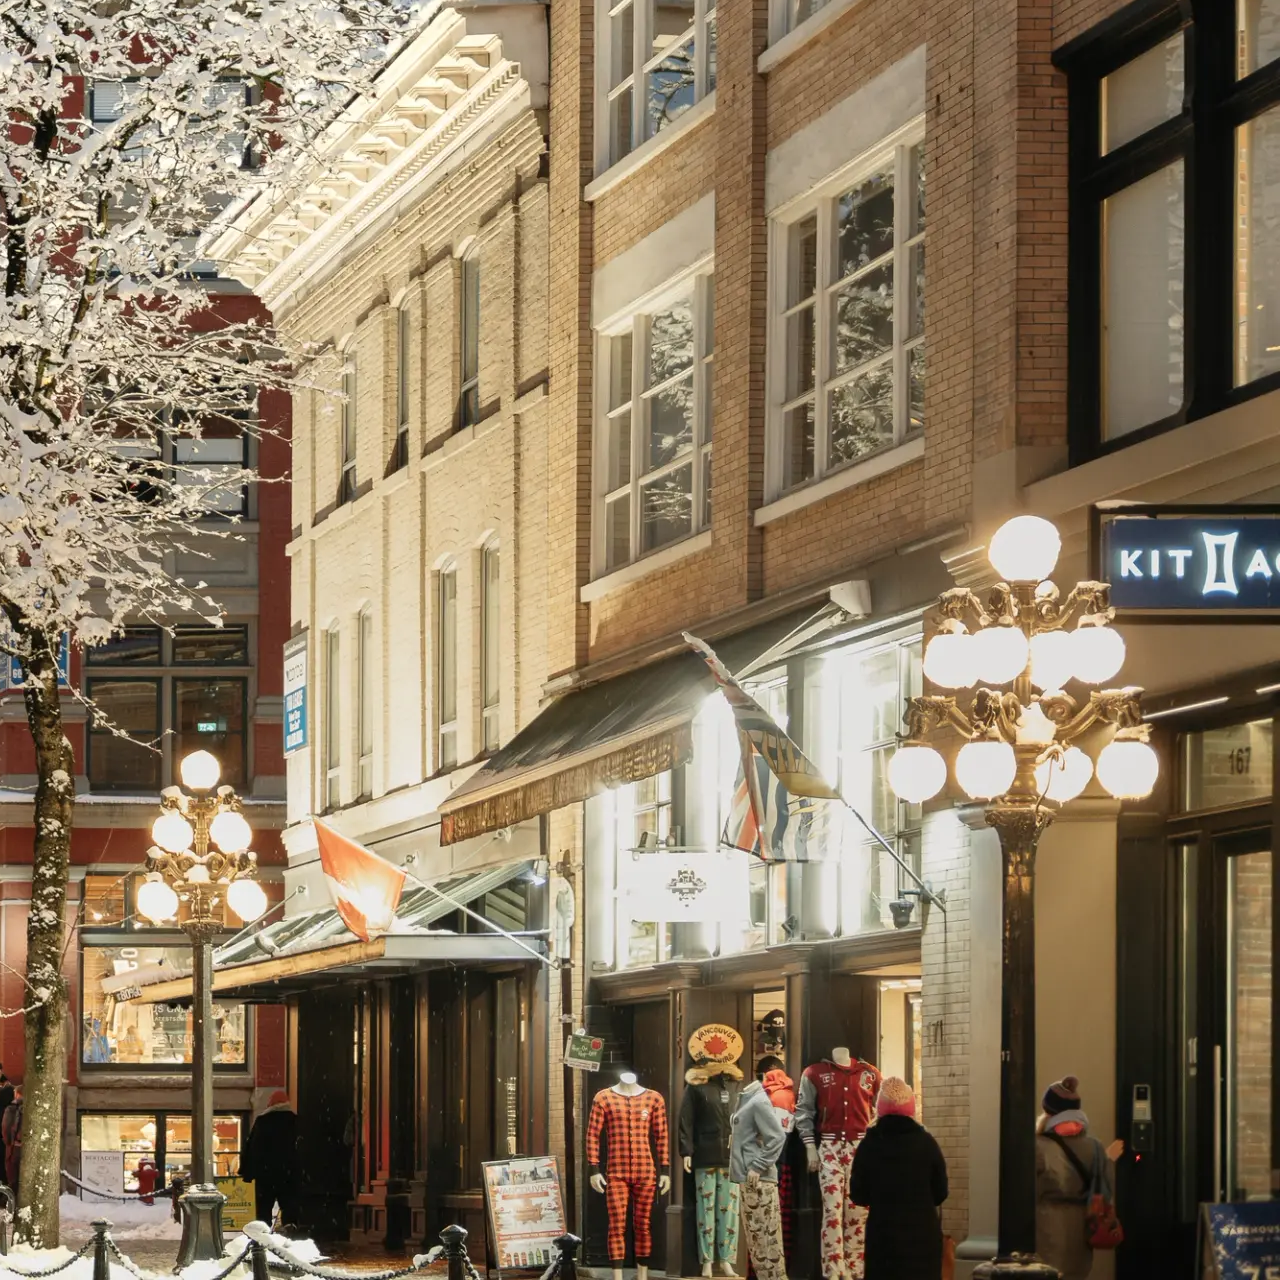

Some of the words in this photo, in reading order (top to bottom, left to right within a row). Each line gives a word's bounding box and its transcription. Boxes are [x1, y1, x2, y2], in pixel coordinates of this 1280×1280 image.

[1120, 549, 1193, 578] KIT
[1245, 549, 1280, 578] A
[1229, 746, 1251, 775] 167
[695, 1027, 737, 1043] VANCOUVER
